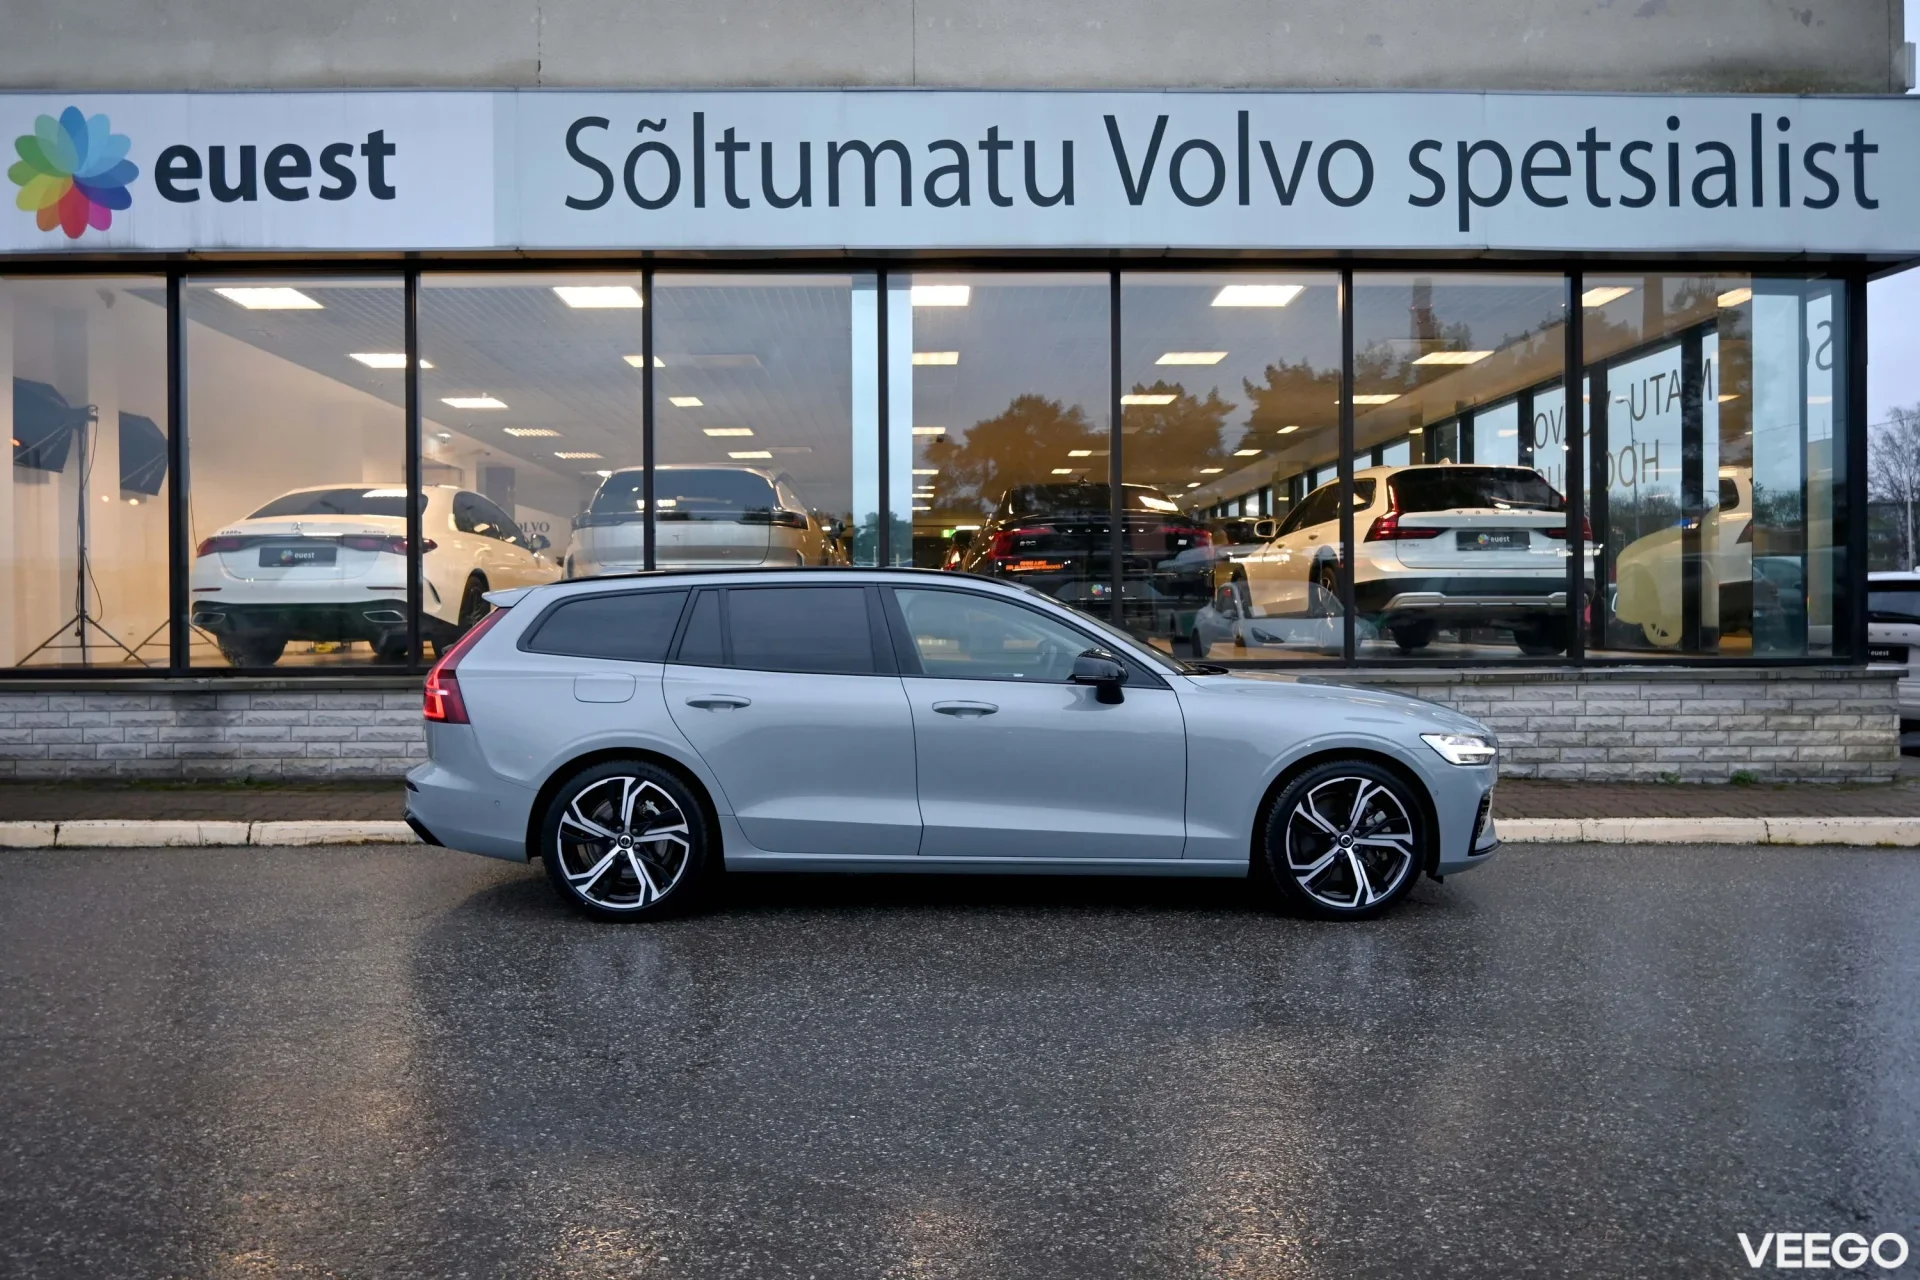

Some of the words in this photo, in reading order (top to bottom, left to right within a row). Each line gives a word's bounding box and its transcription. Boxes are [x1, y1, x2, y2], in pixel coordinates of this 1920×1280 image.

[155, 129, 396, 203] euest
[564, 111, 1075, 211] Sõltumatu
[1103, 110, 1375, 208] Volvo
[1408, 112, 1879, 233] spetsialist
[1490, 535, 1511, 543] euest
[294, 551, 315, 559] euest
[1870, 649, 1890, 657] euest
